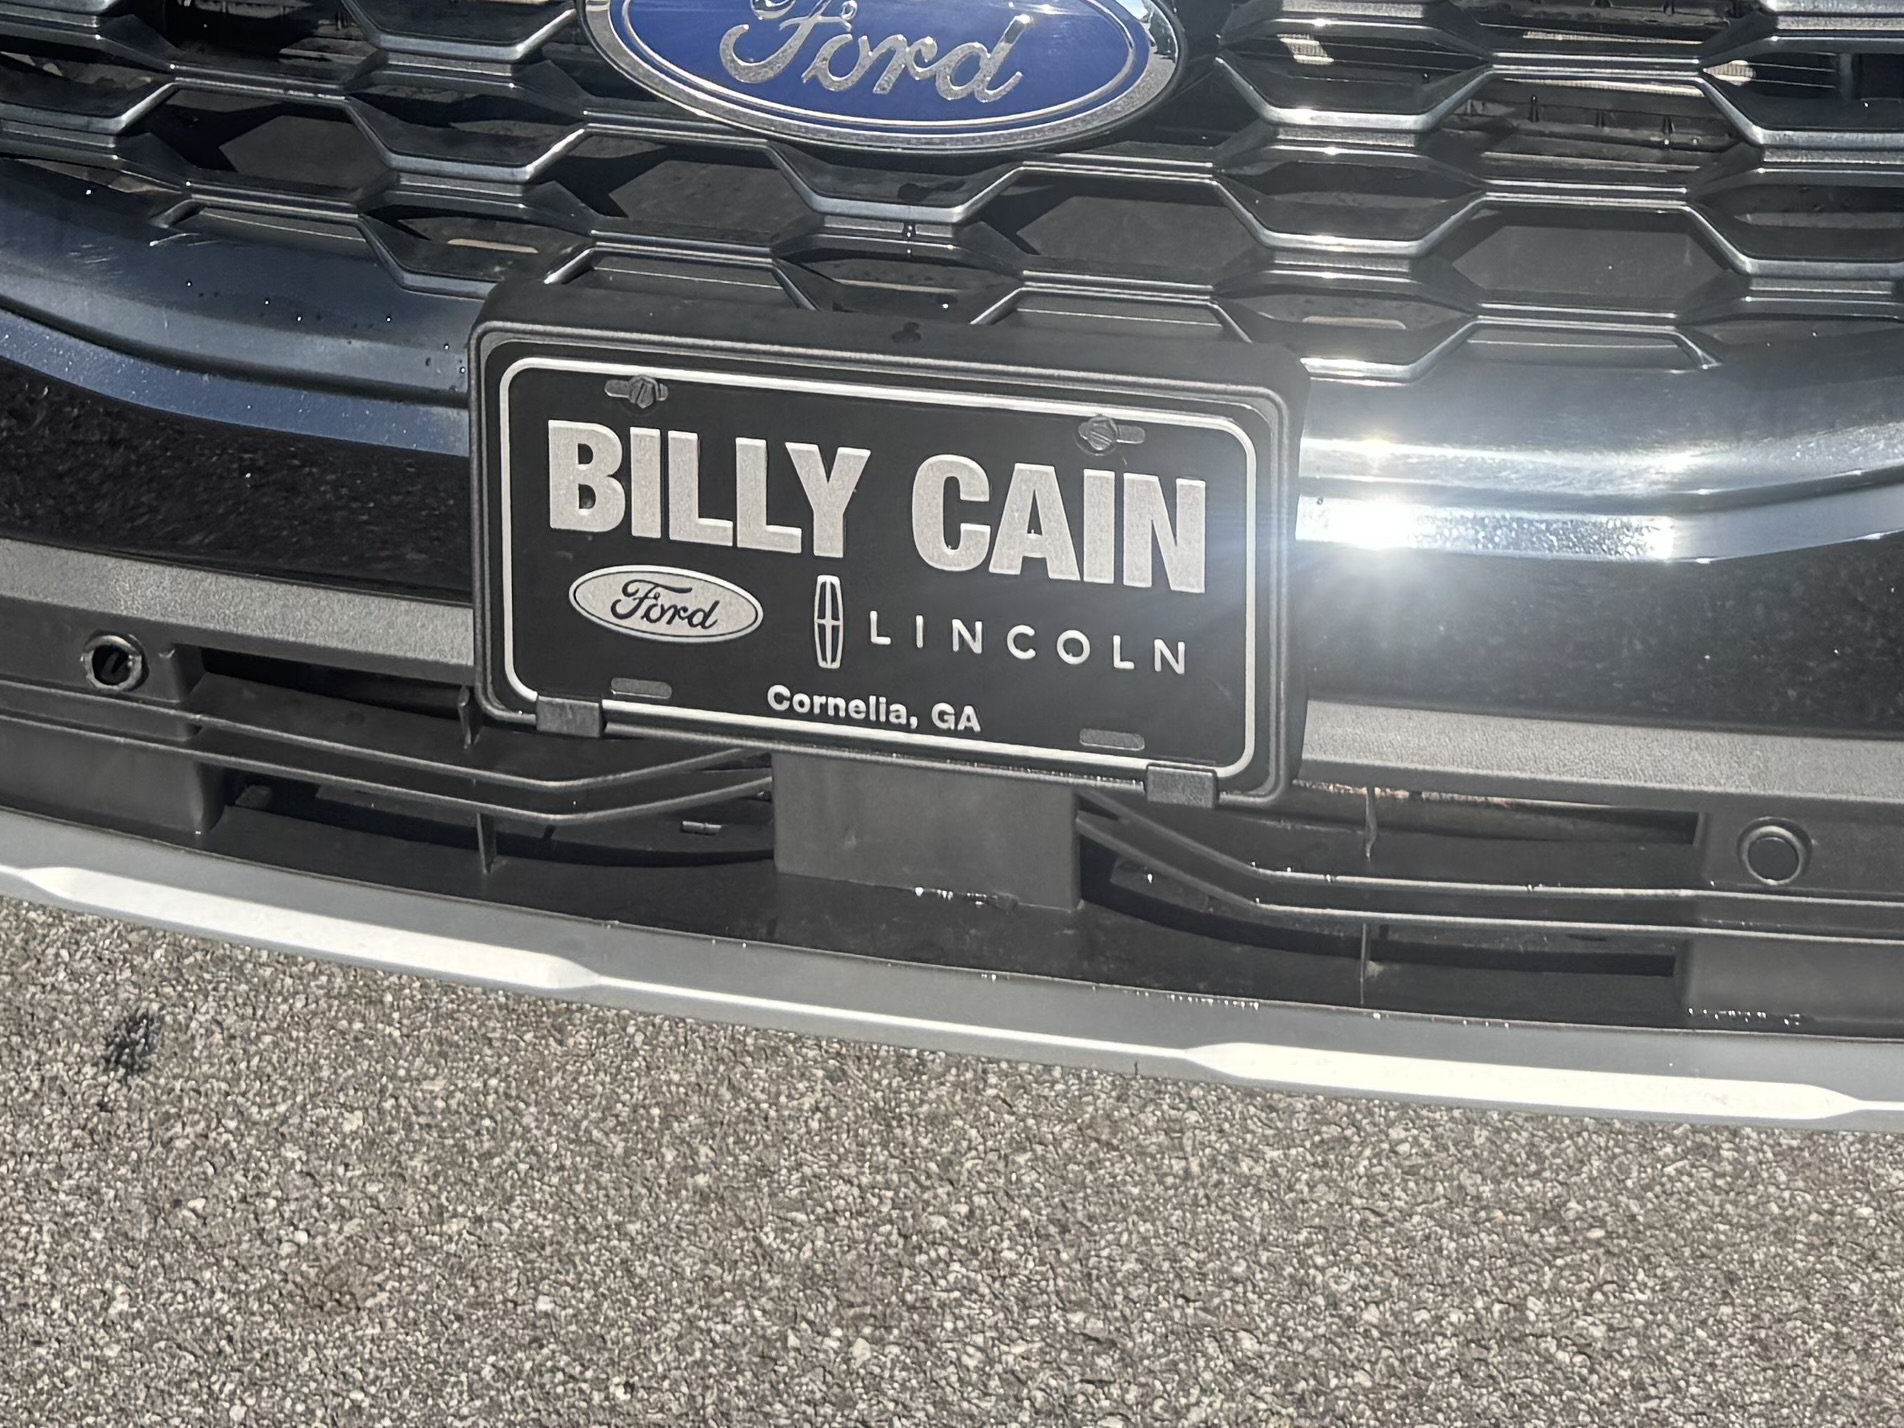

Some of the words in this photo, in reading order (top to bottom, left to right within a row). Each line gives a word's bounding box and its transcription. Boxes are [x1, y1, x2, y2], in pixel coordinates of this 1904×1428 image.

[547, 418, 872, 559] BILLY
[910, 453, 1208, 595] CAIN
[610, 578, 721, 630] Ford
[869, 610, 1186, 675] LINCOLN
[766, 684, 919, 730] Cornelia,
[930, 702, 982, 733] GA
